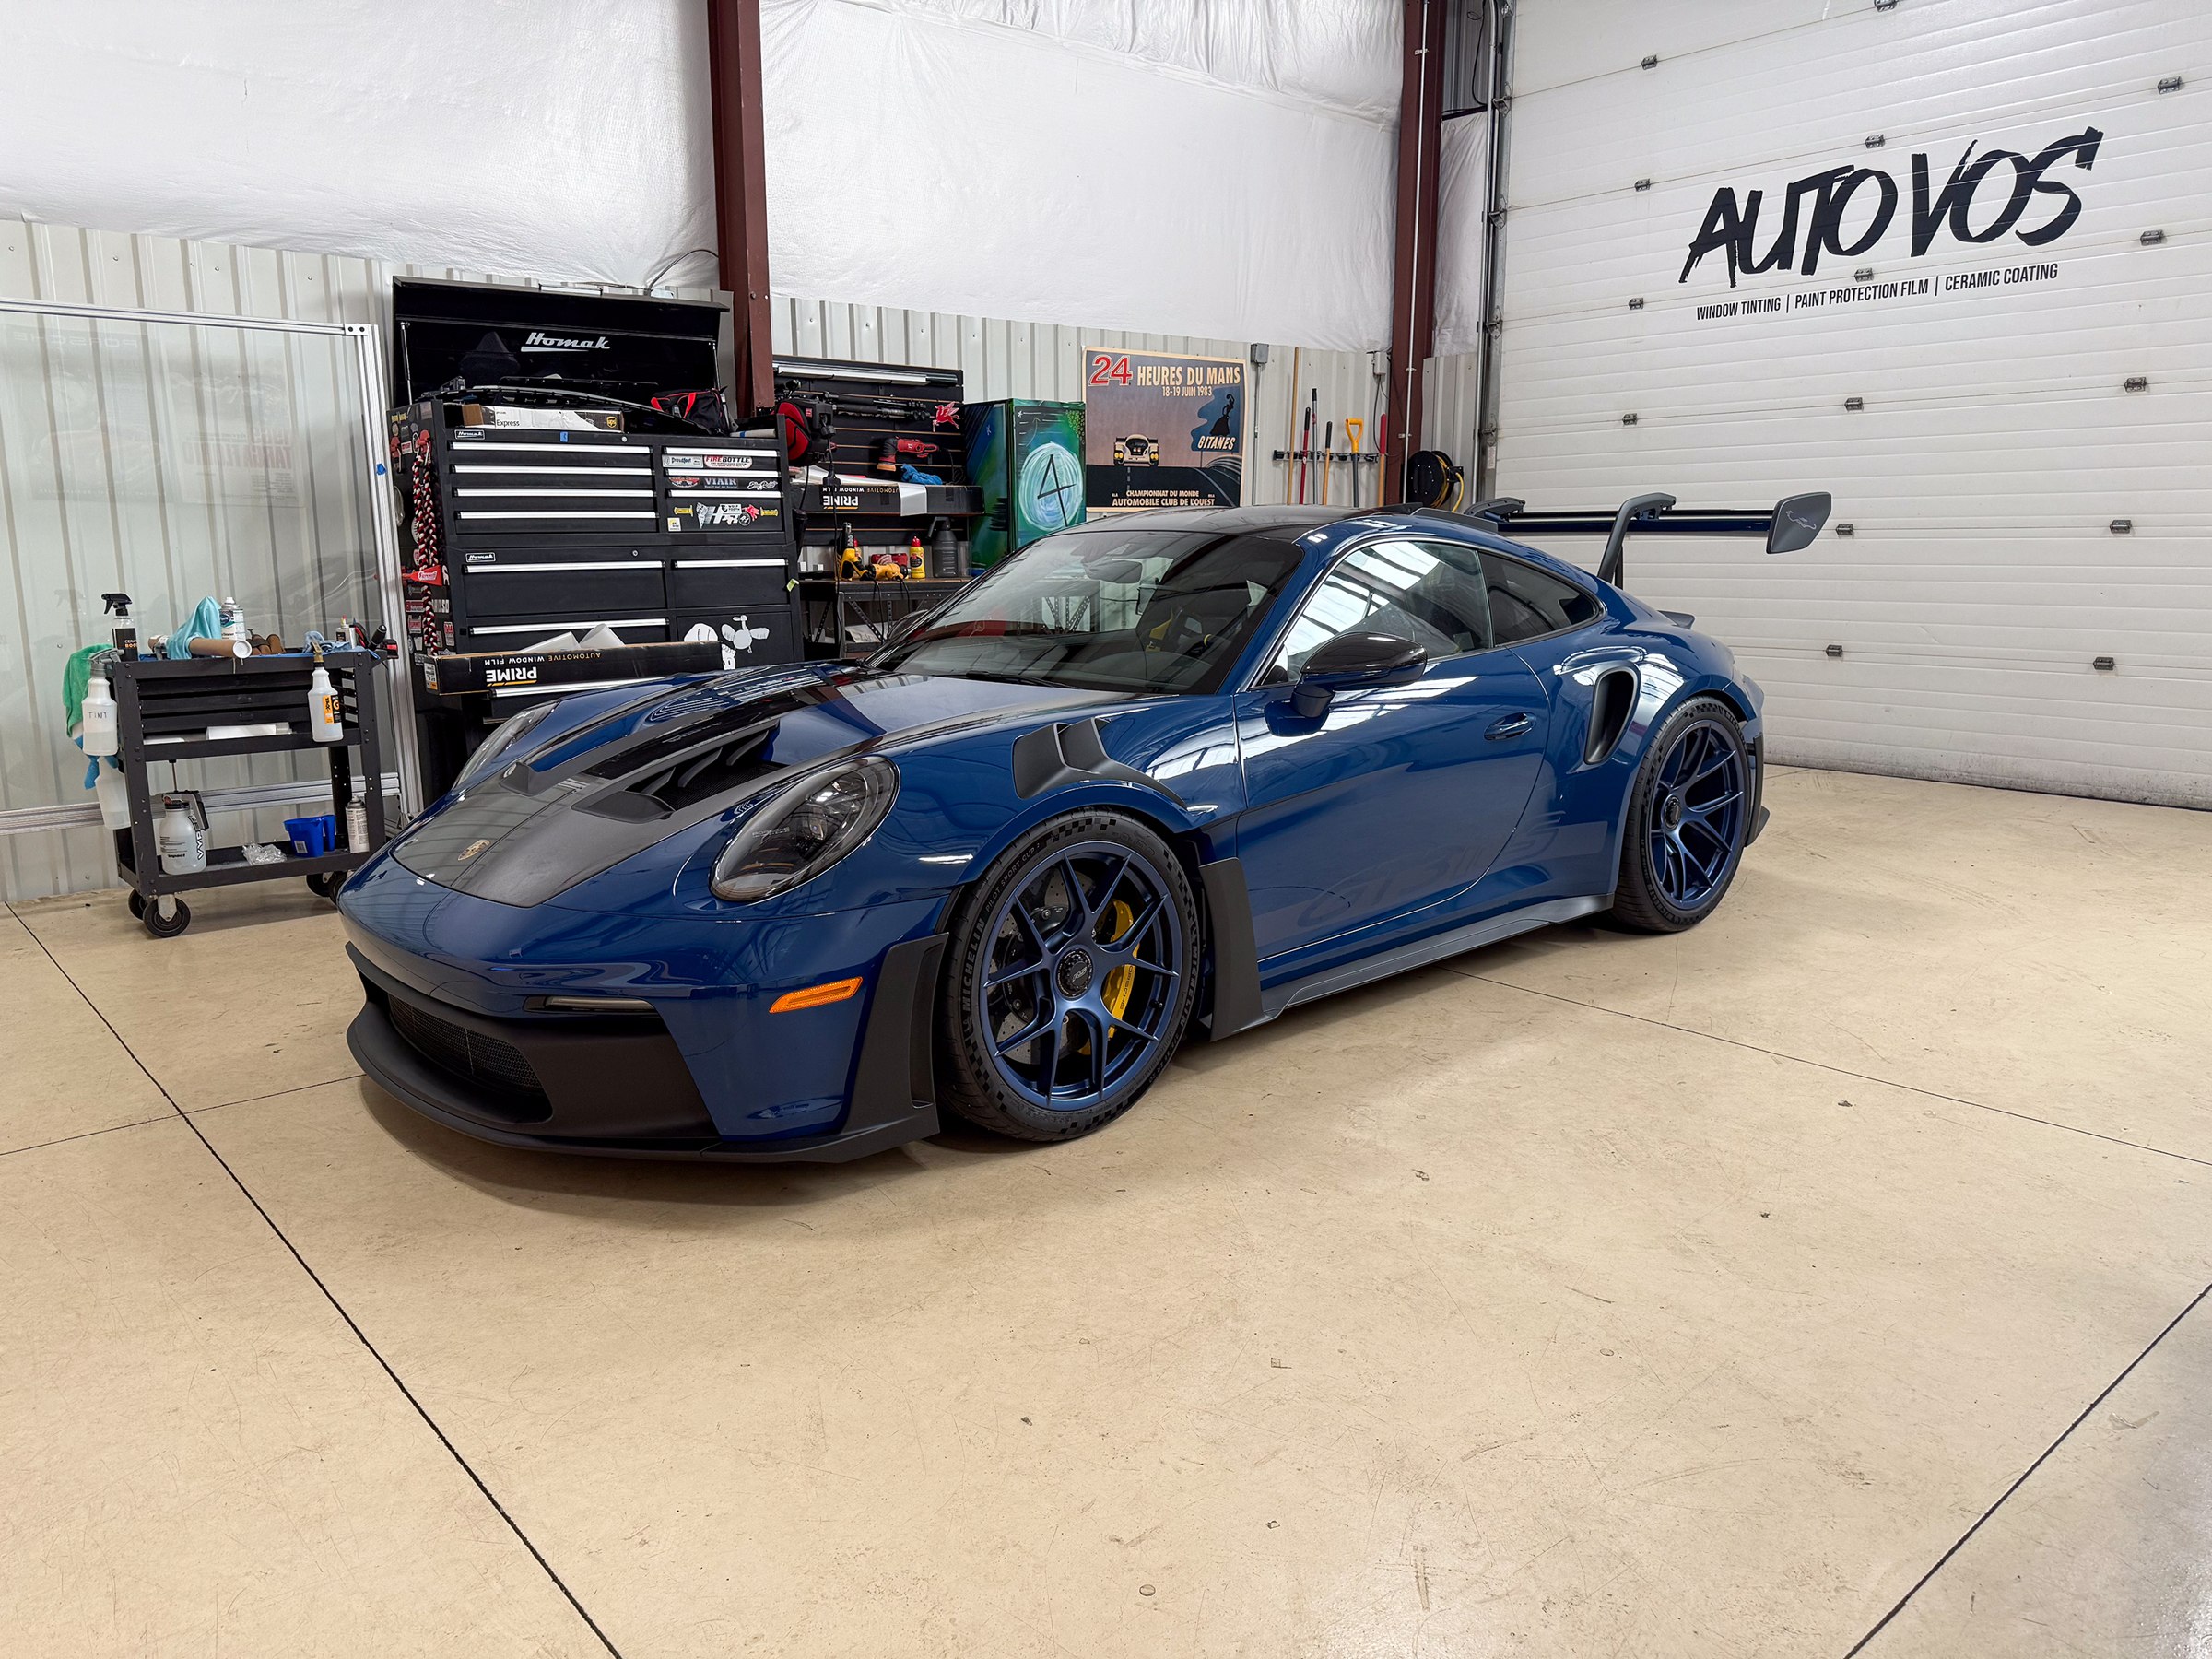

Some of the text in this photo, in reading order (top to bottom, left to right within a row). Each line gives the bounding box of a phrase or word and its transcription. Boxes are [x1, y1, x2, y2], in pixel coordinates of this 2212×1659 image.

[1678, 126, 2104, 288] AUTO VOS
[1697, 263, 2058, 320] WINDOW TINTING PAINT PROTECTION FILM CERAMIC COATING
[525, 331, 611, 349] Homak
[1088, 354, 1241, 387] 24 HEURES DU MANS
[1162, 386, 1212, 397] 18-19 JUIN 1983
[496, 419, 520, 428] Express
[1197, 435, 1236, 451] GITANES
[704, 477, 737, 486] VIAIR
[1125, 489, 1169, 498] CHAMPIONNAT
[1112, 498, 1216, 507] AUTOMOBILE CLUB DE L'OUEST
[484, 652, 602, 665] AUTOMOTIVE WINDOW FILM
[486, 666, 537, 683] PRIME
[88, 711, 108, 719] TINT
[985, 890, 1001, 912] PILOT
[1000, 864, 1021, 888] SPORT
[1021, 847, 1035, 863] CUP
[962, 918, 984, 1011] MICHELIN
[1119, 965, 1134, 1010] ORSCHE
[1180, 945, 1197, 1028] MICHELIN
